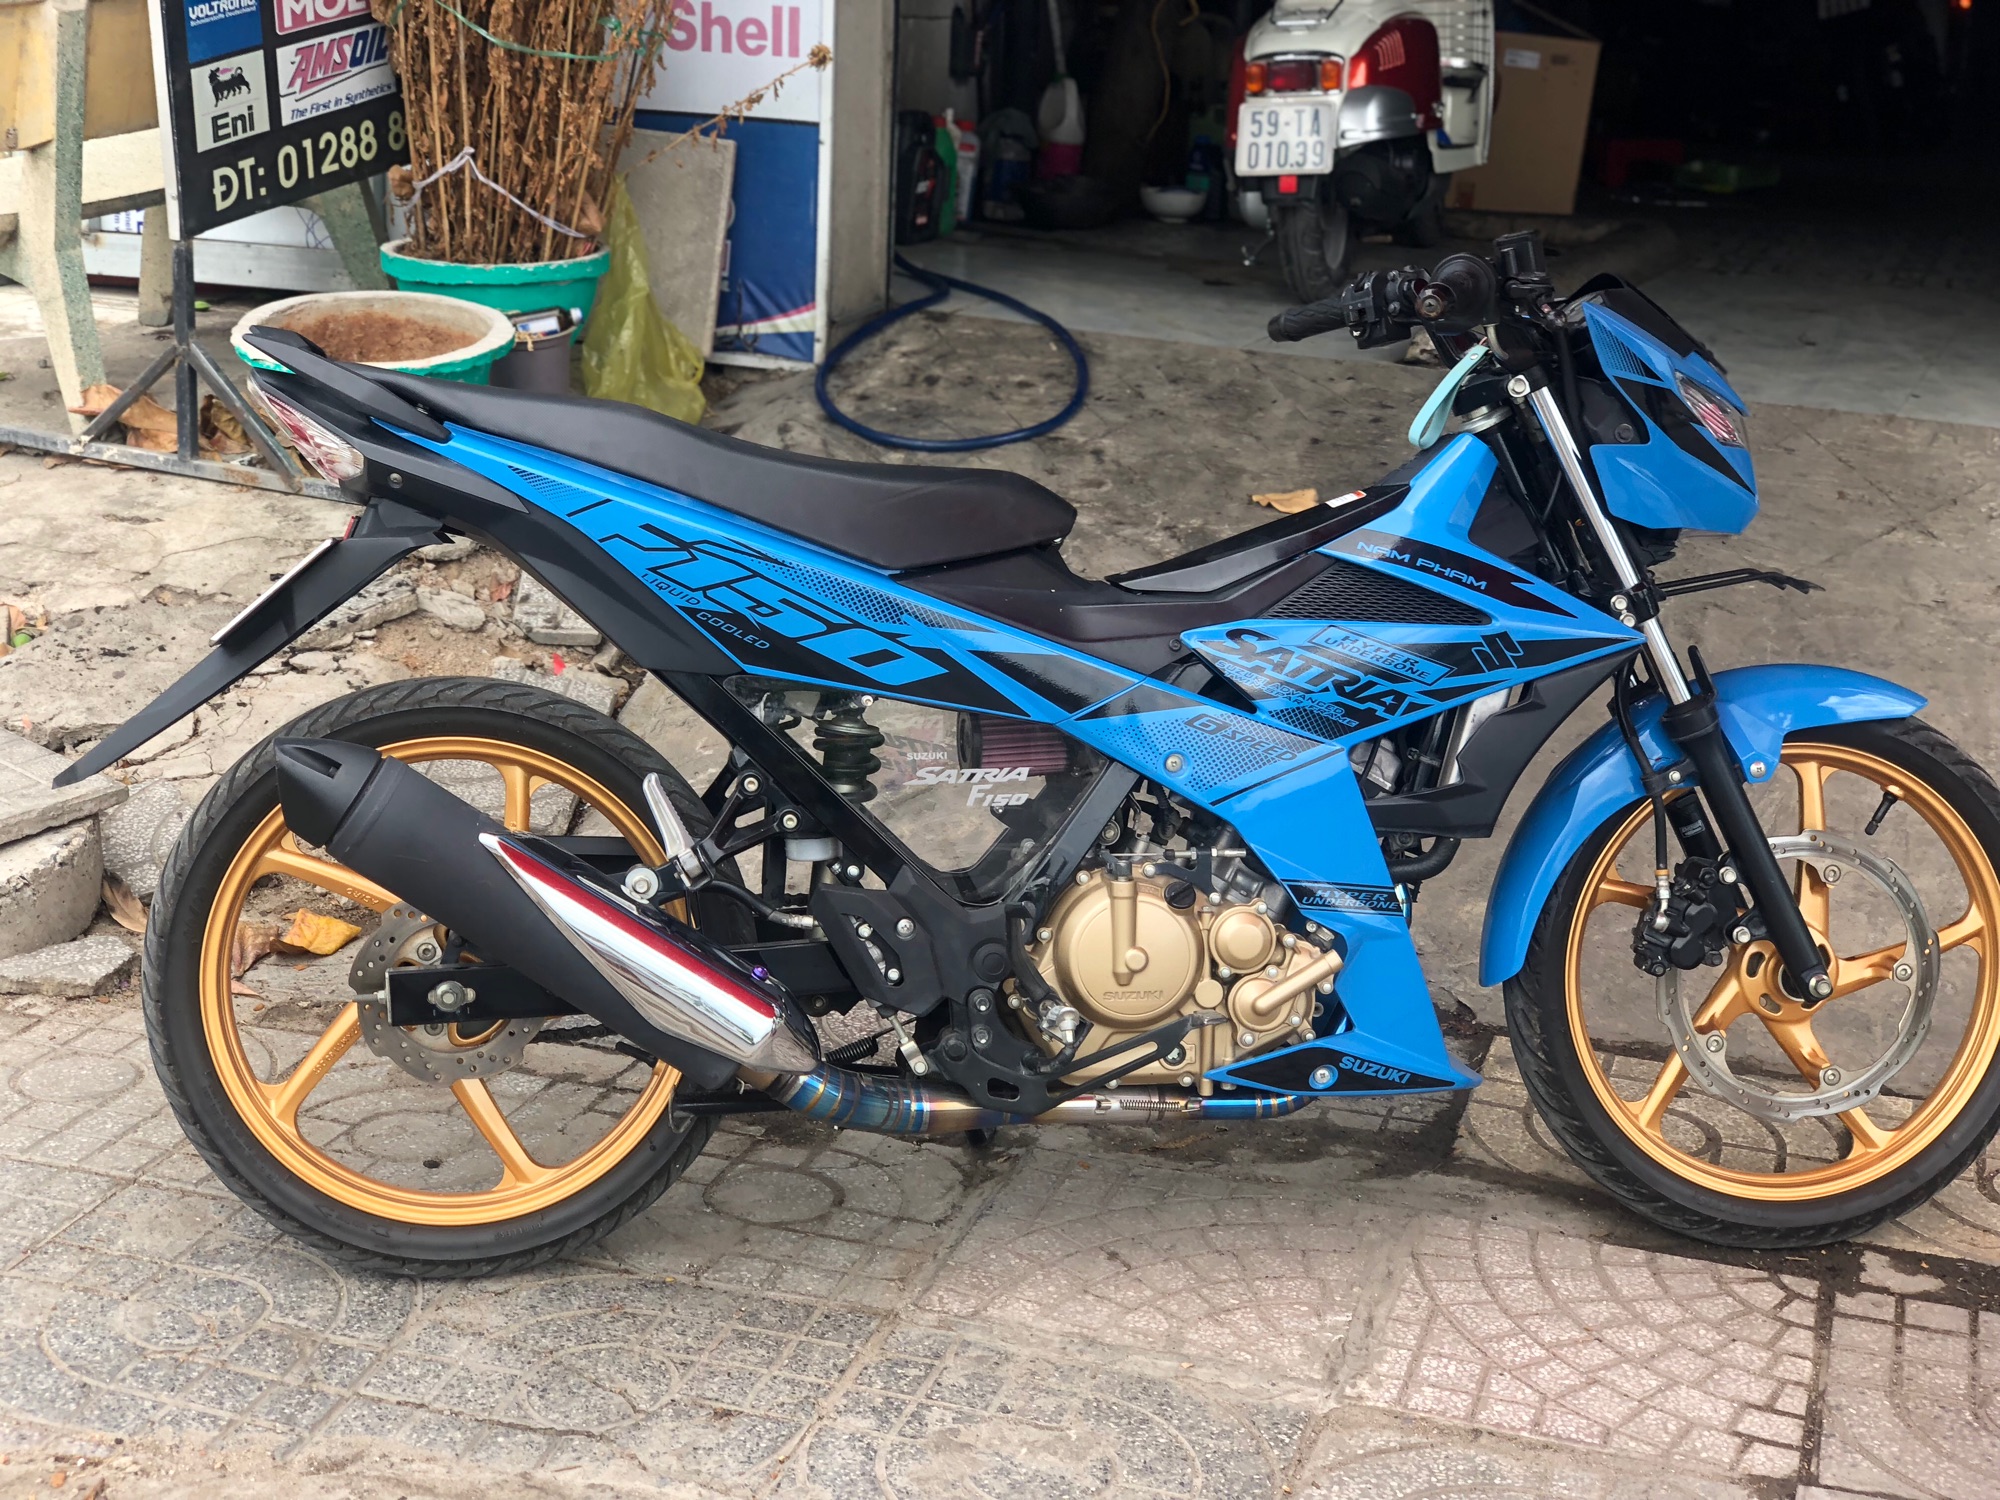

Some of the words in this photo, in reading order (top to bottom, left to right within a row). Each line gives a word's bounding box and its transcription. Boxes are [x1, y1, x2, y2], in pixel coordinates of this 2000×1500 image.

[665, 0, 800, 58] Shell
[287, 26, 389, 94] AMSOIL
[291, 106, 308, 120] The
[310, 99, 332, 114] First
[334, 96, 343, 108] in
[345, 83, 392, 106] Synthetics
[211, 104, 255, 143] Eni
[1250, 108, 1322, 138] 59-TA
[213, 157, 267, 212] ĐT:
[277, 119, 378, 189] 01288
[1247, 140, 1326, 169] 010.39
[1356, 541, 1411, 563] NAM
[1415, 558, 1488, 590] PHAM
[641, 573, 701, 606] LIQUID
[696, 611, 770, 649] COOLED
[1324, 637, 1432, 680] UNDERBONE
[1340, 635, 1420, 668] HYPER
[1203, 628, 1412, 717] SATRIA
[1215, 660, 1270, 686] SUZUKI
[1267, 682, 1346, 715] ADVANCED
[1304, 704, 1360, 728] FRAME
[906, 751, 948, 760] SUZUKI
[1222, 729, 1298, 762] SPEED
[903, 766, 1032, 785] SATRIA
[966, 784, 1029, 807] F150
[1302, 896, 1400, 910] UNDERBONE
[1315, 889, 1389, 901] HYPER
[1103, 990, 1164, 1001] SUZUKI
[1339, 1055, 1411, 1084] SUZUKI
